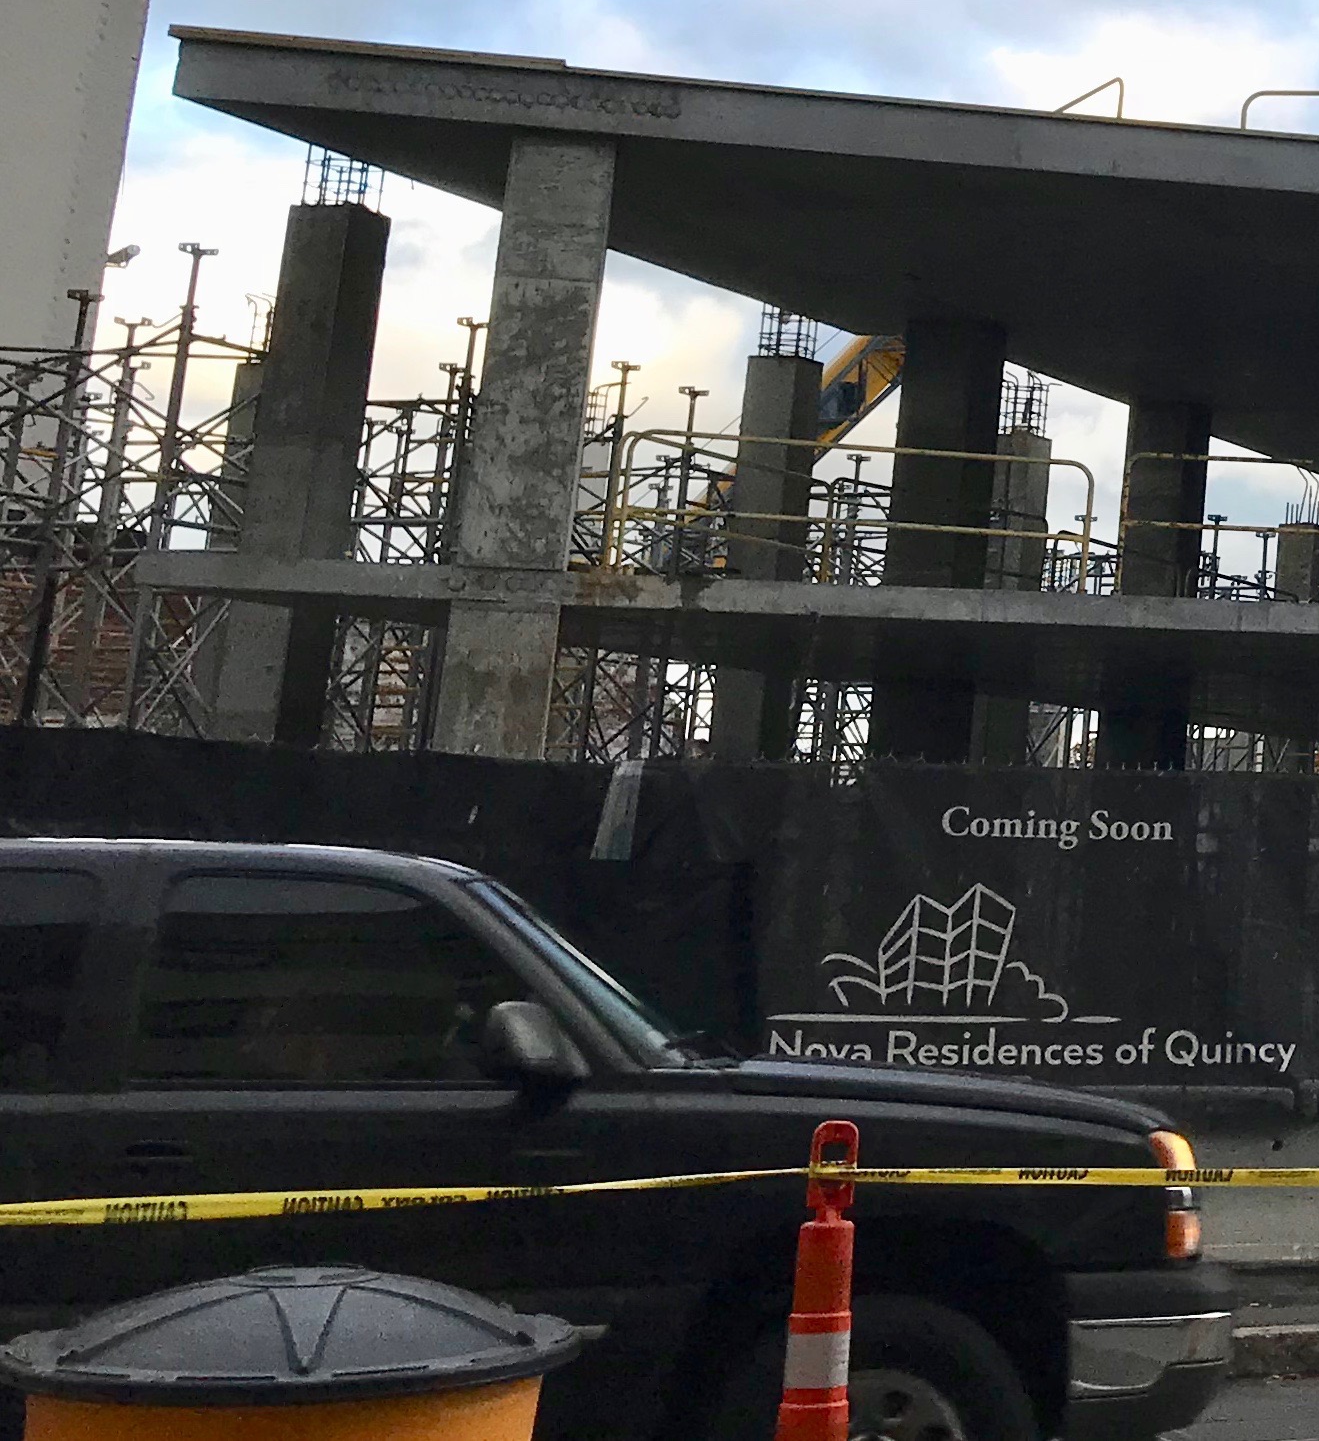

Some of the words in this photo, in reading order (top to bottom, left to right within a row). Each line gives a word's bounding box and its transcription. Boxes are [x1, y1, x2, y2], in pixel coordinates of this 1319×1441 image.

[941, 806, 1081, 850] Coming
[1088, 809, 1174, 841] Soon
[768, 1029, 873, 1062] Nova
[886, 1027, 1104, 1066] Residences
[1115, 1027, 1157, 1065] of
[1165, 1029, 1297, 1072] Quincy
